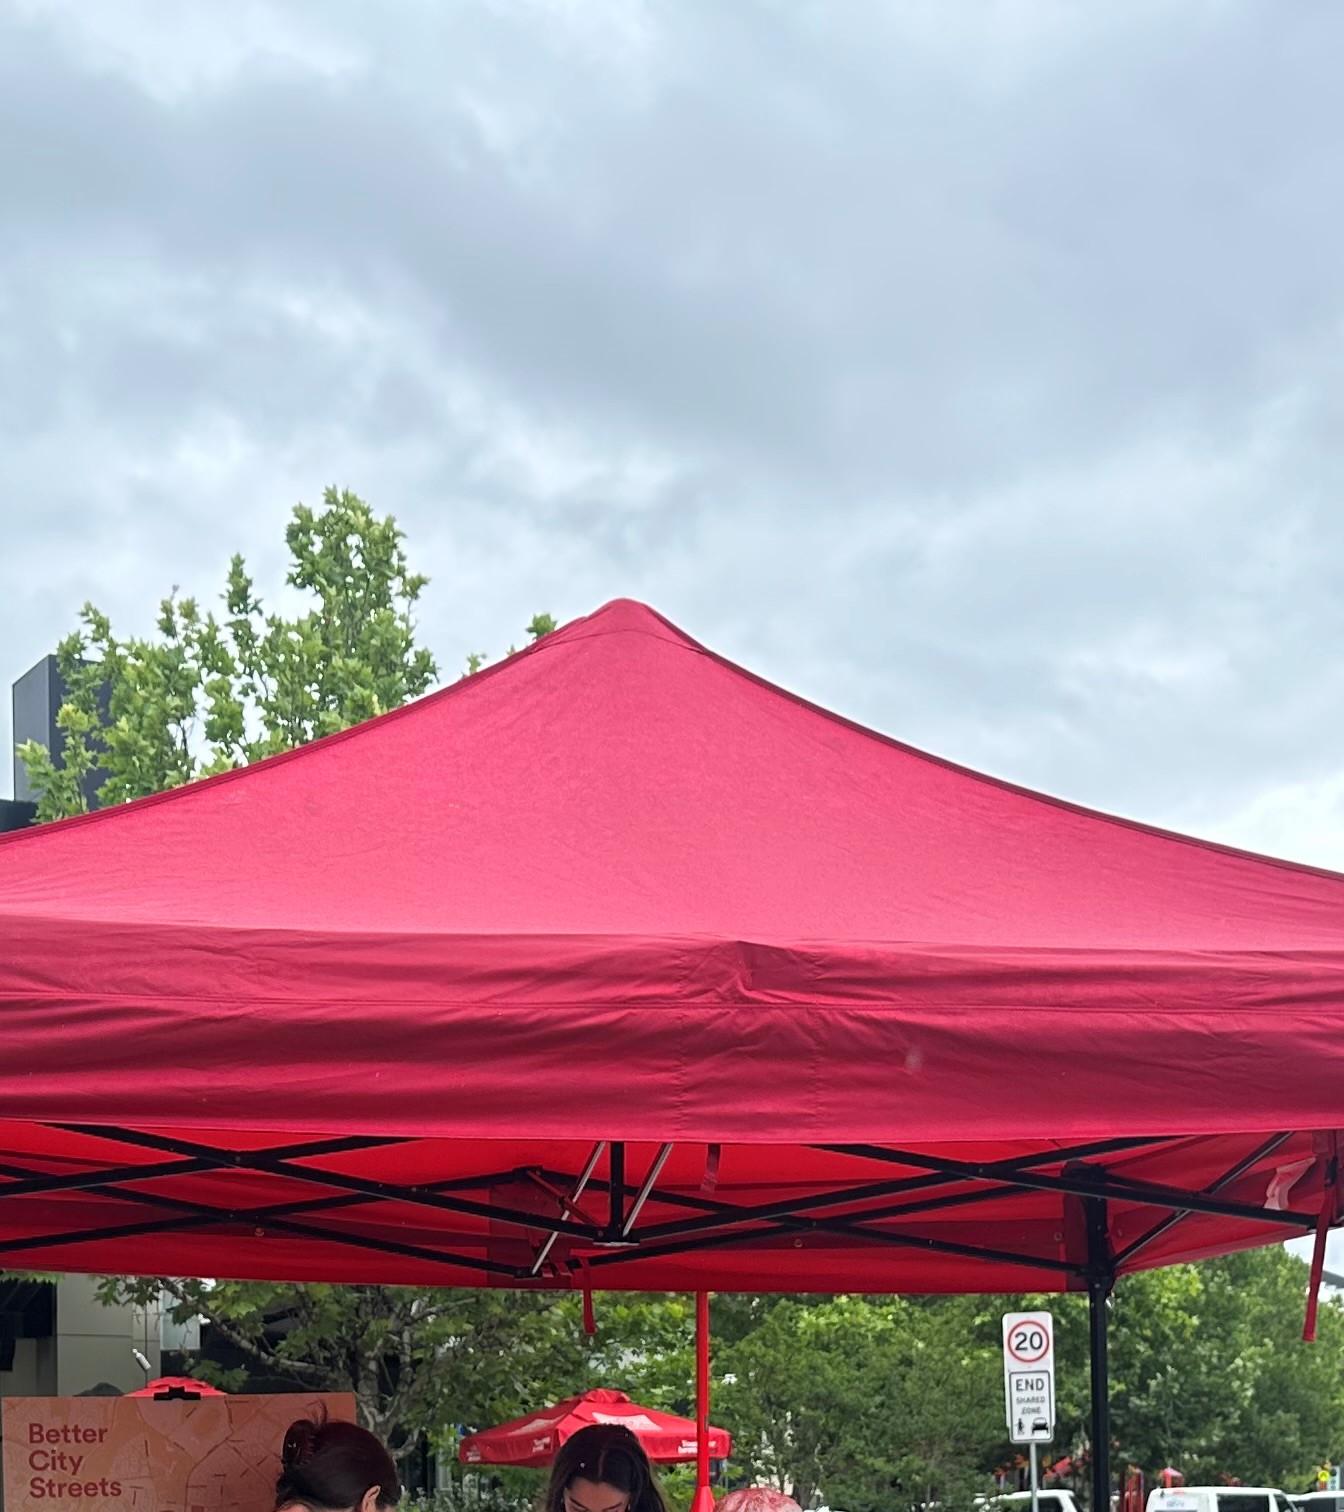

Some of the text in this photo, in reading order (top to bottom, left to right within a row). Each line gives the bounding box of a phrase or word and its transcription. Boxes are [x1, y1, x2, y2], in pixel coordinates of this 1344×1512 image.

[1014, 1331, 1043, 1351] 20
[1015, 1378, 1045, 1392] END
[1016, 1396, 1046, 1405] SHARED
[1021, 1406, 1042, 1415] ZONE
[29, 1423, 108, 1444] Better
[29, 1449, 84, 1476] City
[29, 1477, 122, 1498] Streets
